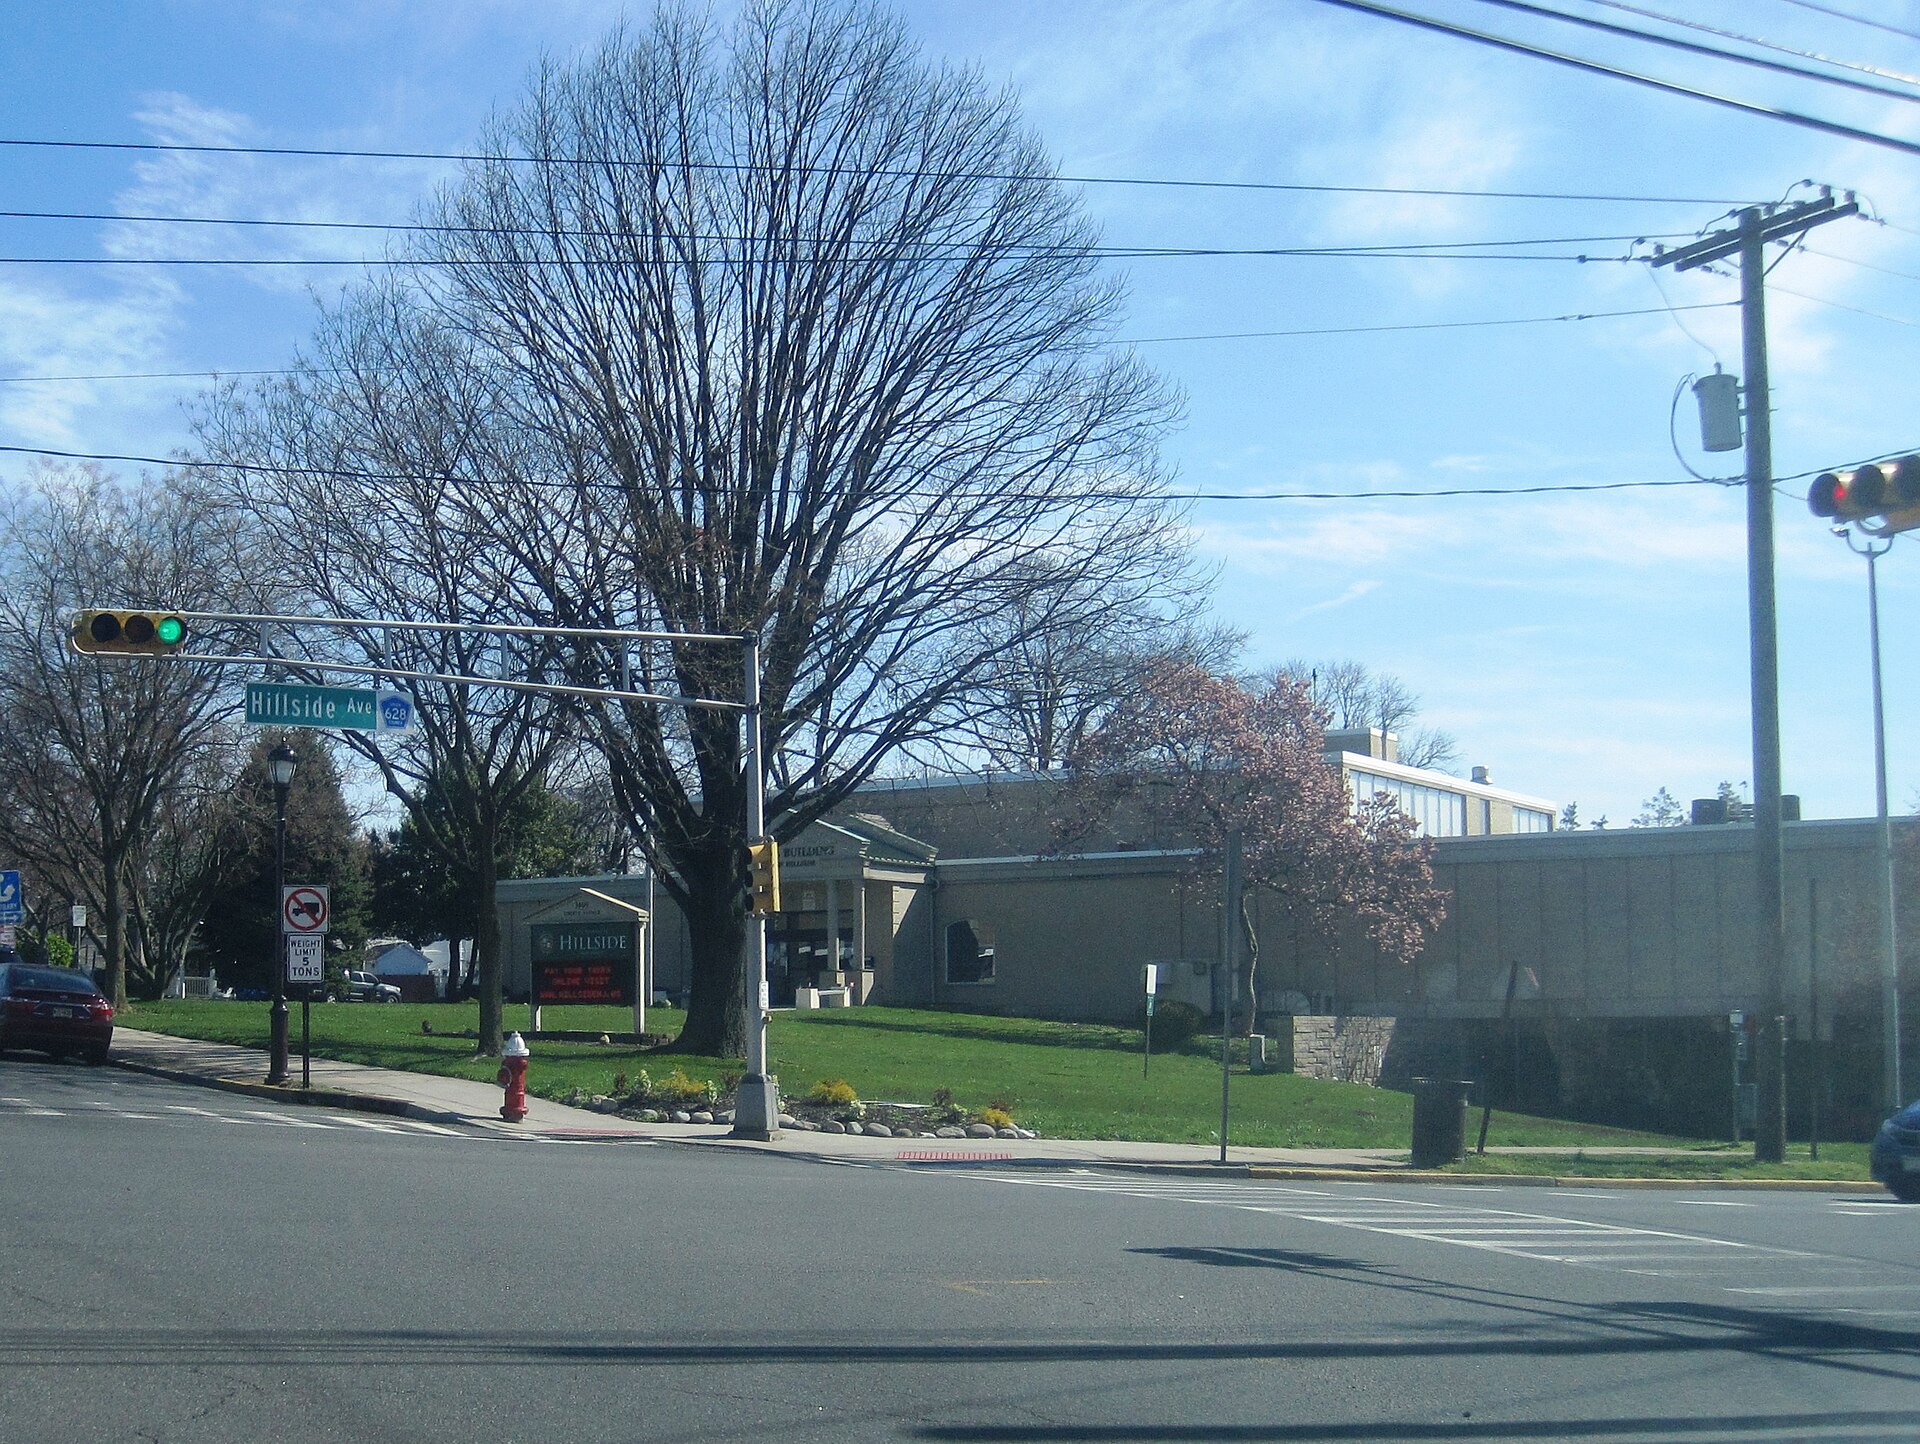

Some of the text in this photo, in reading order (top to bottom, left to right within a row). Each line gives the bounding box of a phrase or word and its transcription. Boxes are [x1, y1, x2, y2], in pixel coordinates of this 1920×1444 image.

[251, 691, 372, 719] Hillside Ave
[385, 707, 407, 720] 628
[783, 845, 835, 857] BUILDING
[560, 935, 626, 950] HILLSIDE
[295, 948, 316, 956] LIMIT
[302, 957, 309, 966] 5
[292, 966, 319, 976] TONS
